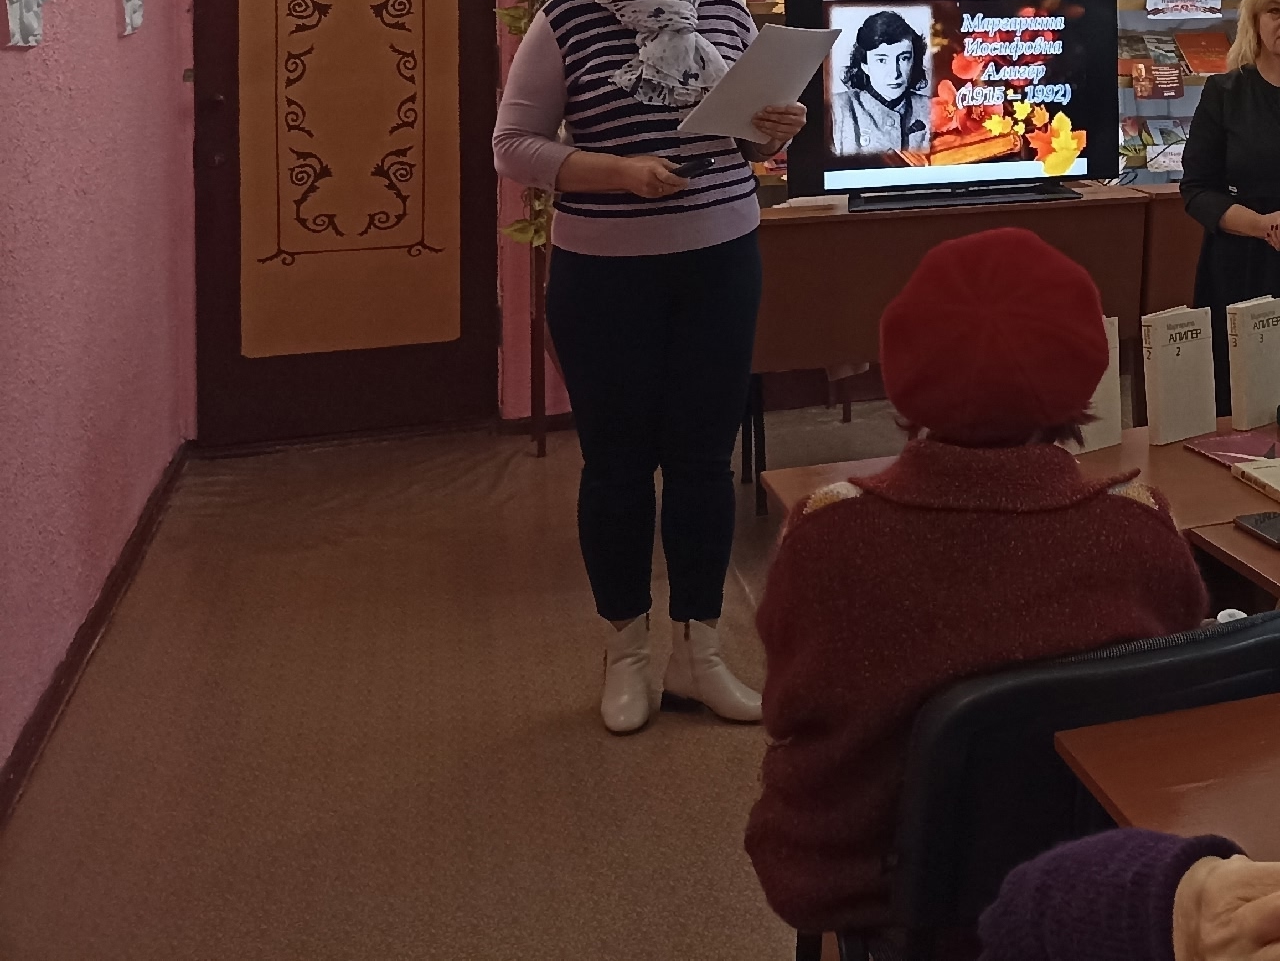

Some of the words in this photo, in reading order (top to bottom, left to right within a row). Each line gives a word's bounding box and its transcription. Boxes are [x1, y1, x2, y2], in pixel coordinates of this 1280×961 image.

[961, 13, 1066, 36] Маргарита
[963, 37, 1063, 61] Иосифовна
[981, 62, 1046, 84] Алигер
[1024, 84, 1072, 105] 1992)
[1175, 347, 1181, 356] 2
